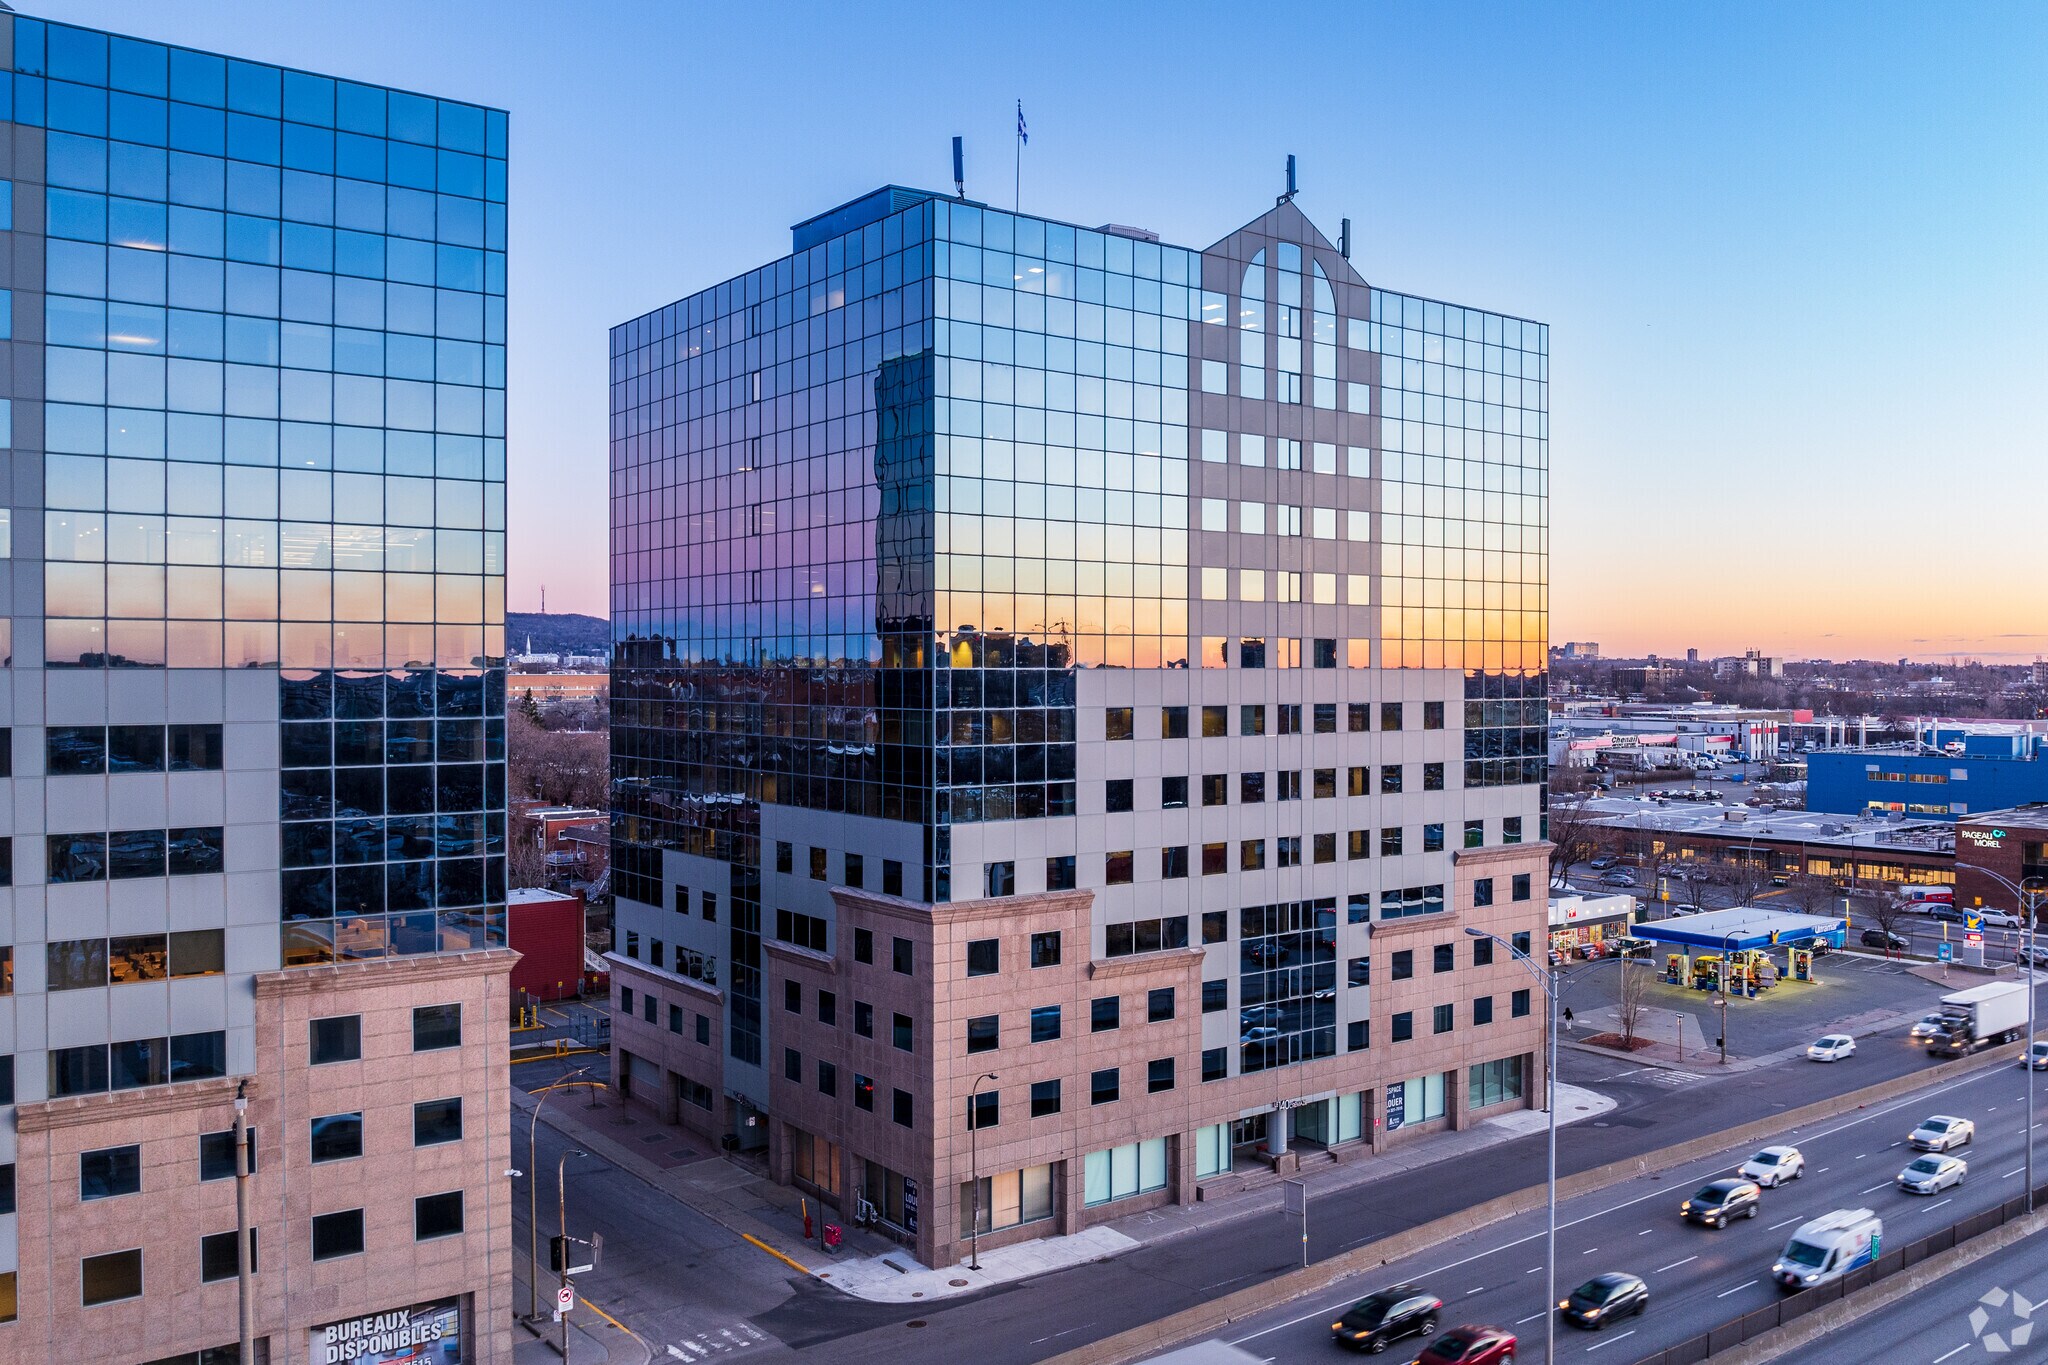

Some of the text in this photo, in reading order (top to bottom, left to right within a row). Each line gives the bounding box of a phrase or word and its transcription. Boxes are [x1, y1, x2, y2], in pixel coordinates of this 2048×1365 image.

[1961, 830, 1993, 839] PAGEAU
[1974, 840, 2001, 848] MOREL
[1387, 1097, 1403, 1108] OUER
[326, 1310, 409, 1344] BUREAUX
[326, 1322, 442, 1364] DISPONIBLES
